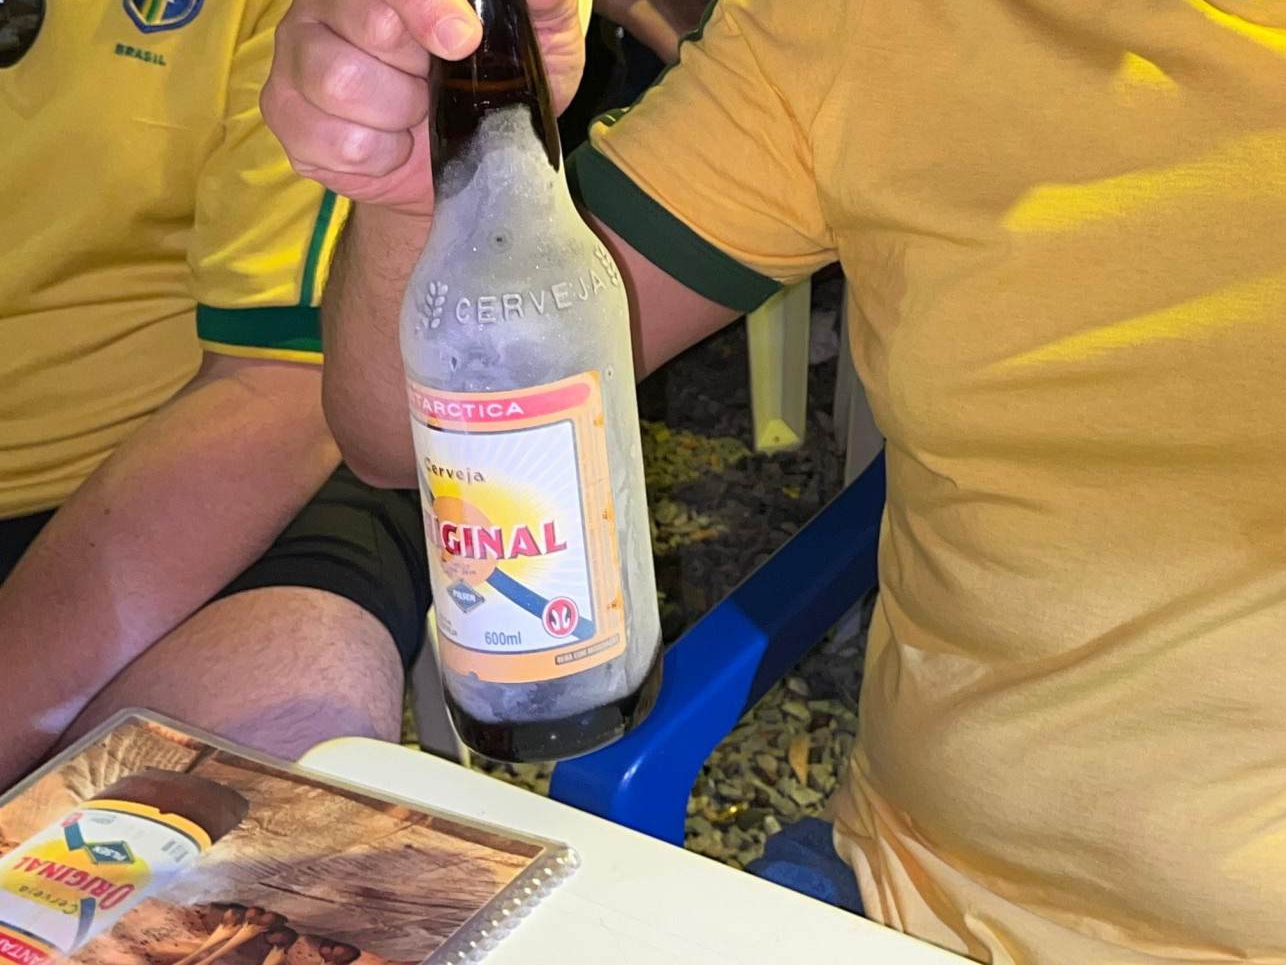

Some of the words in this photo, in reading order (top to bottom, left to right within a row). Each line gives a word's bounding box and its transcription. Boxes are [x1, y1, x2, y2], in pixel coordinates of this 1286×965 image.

[114, 43, 167, 66] BRASIL
[455, 268, 605, 325] CERVEJA
[423, 456, 486, 484] Cerveja
[484, 631, 522, 646] 600ml
[12, 856, 136, 911] ORIGINAL
